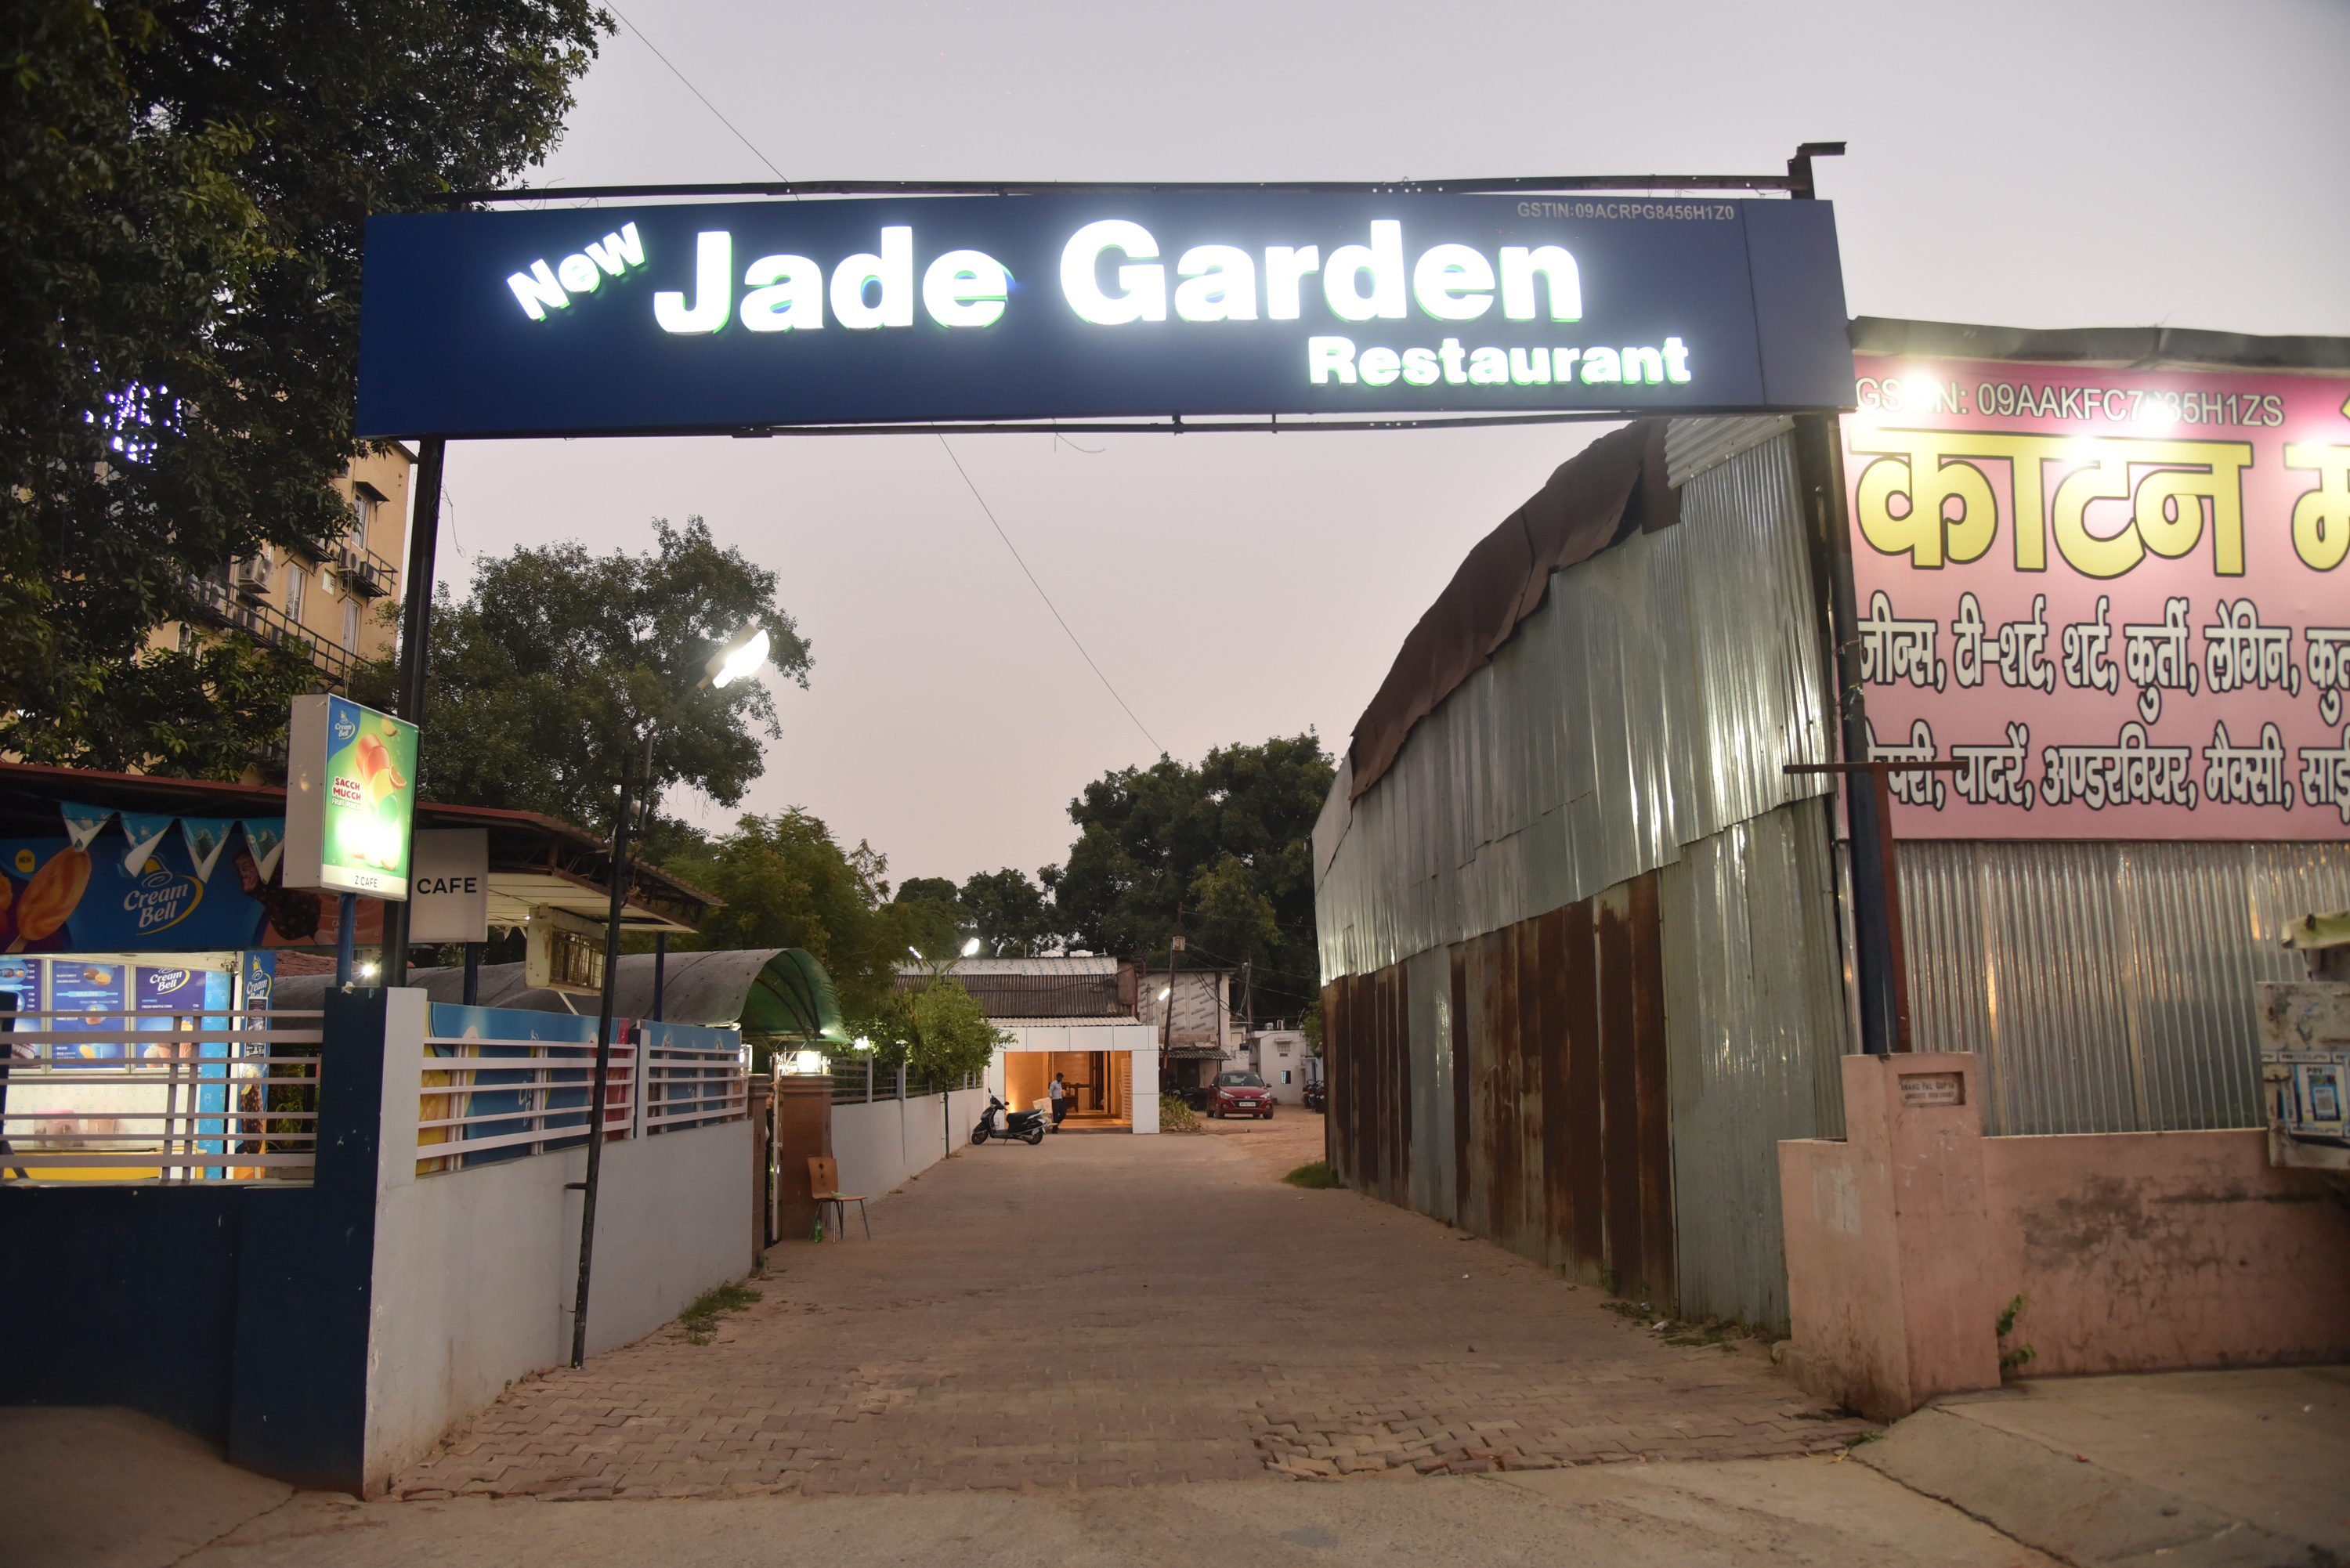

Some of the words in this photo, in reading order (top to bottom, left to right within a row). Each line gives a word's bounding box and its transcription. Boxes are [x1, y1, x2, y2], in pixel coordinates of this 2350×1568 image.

[507, 221, 645, 322] New
[653, 226, 1010, 335] Jade
[1059, 219, 1584, 325] Garden
[1307, 336, 1693, 387] Restaurant
[1849, 427, 2254, 580] काटन
[2062, 595, 2120, 696] शर्ट,
[334, 722, 352, 731] Cream
[334, 777, 360, 791] SACCH
[332, 786, 361, 801] MUCCH
[354, 875, 360, 885] Z
[360, 876, 378, 888] CAFE
[417, 877, 477, 894] CAFE
[123, 883, 189, 911] Cream
[139, 901, 178, 928] Bell
[149, 970, 183, 985] Cream
[157, 980, 177, 992] Bell
[246, 979, 268, 995] Cream
